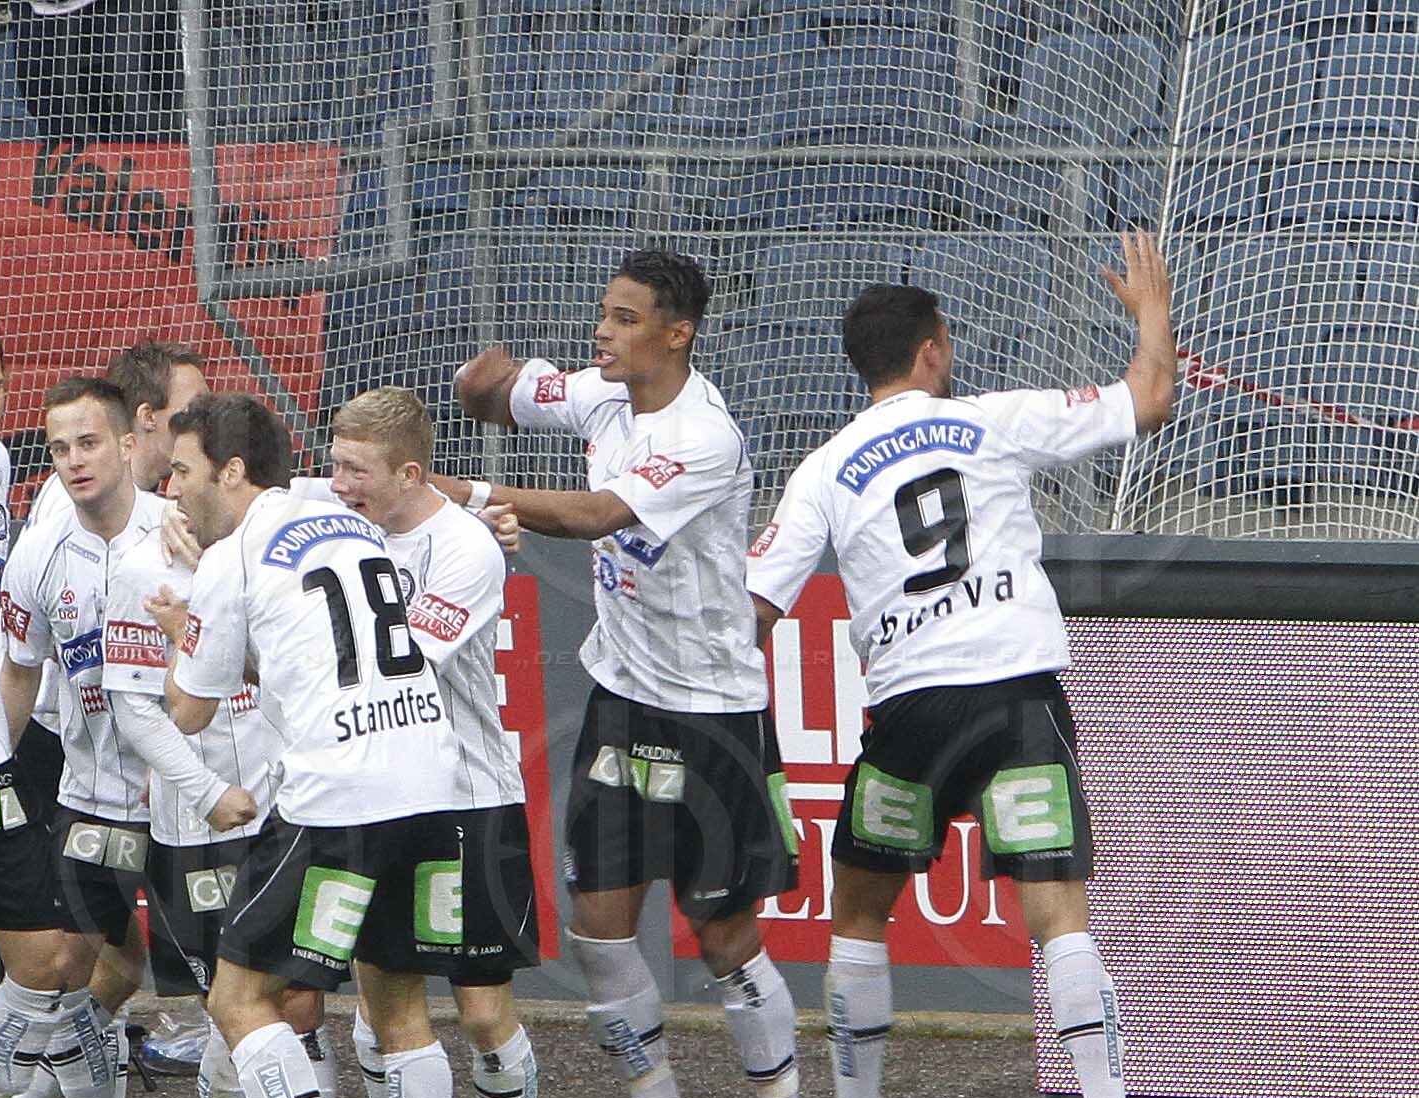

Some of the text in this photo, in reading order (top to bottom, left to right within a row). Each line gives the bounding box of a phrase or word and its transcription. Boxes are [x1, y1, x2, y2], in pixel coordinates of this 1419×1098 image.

[843, 424, 976, 488] PUNTIGAMER
[894, 467, 973, 597] 9
[302, 556, 426, 691] 18
[334, 687, 443, 743] standfes
[863, 779, 917, 840] E
[991, 778, 1060, 842] E
